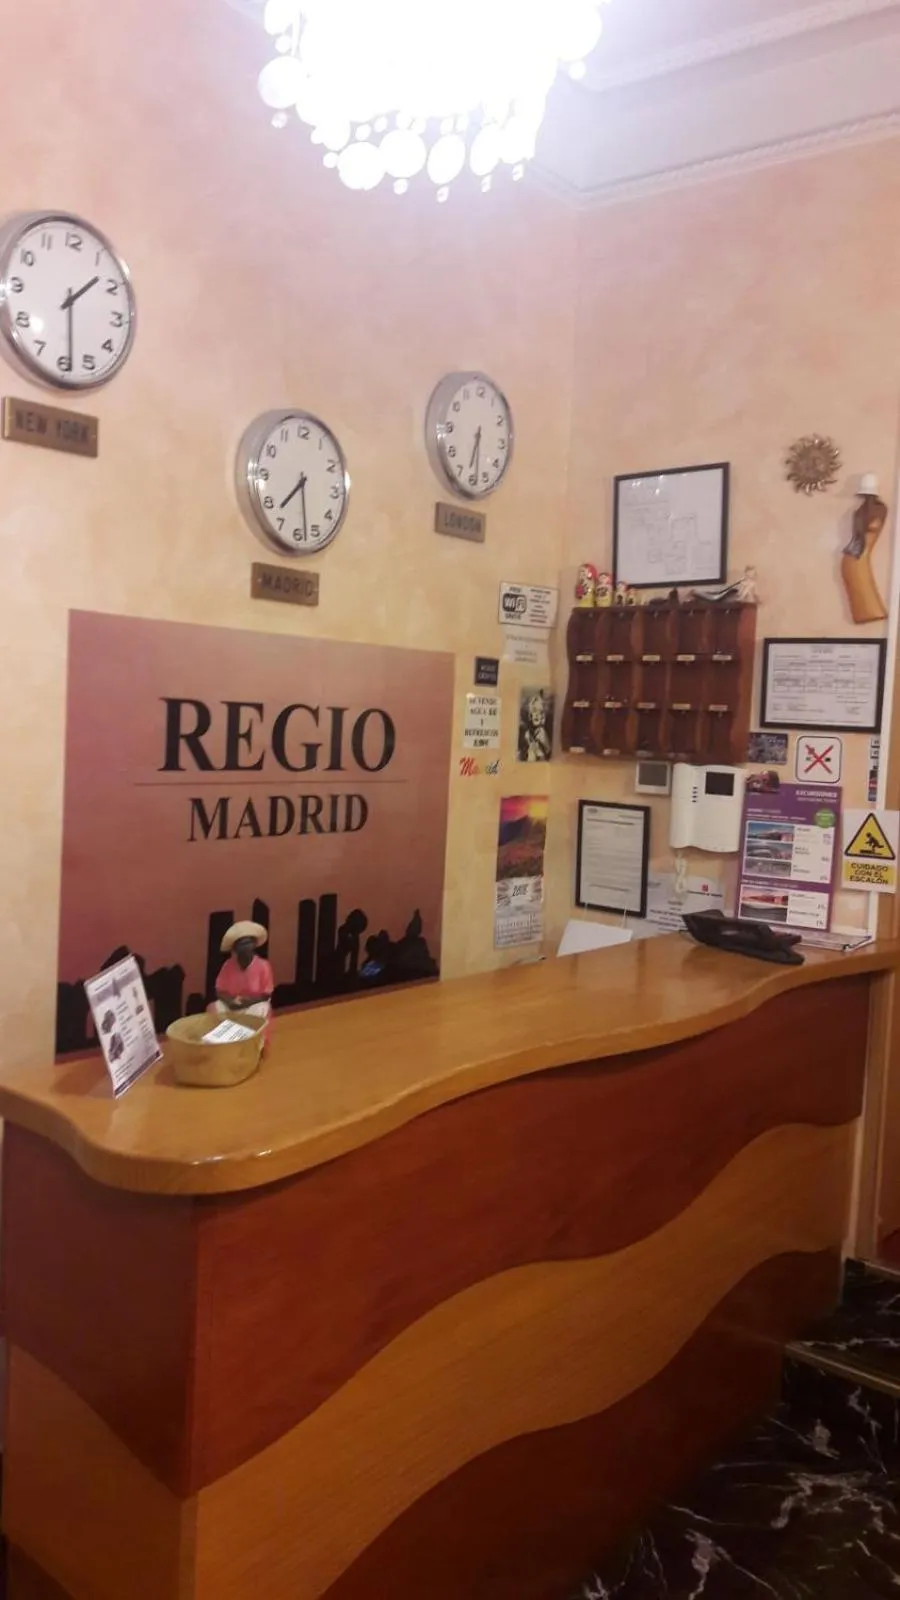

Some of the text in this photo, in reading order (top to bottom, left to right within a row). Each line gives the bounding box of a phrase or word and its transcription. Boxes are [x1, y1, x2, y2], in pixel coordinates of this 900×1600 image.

[41, 232, 52, 251] 11
[65, 232, 82, 252] 12
[20, 249, 35, 267] 10
[95, 251, 100, 267] 1
[10, 277, 24, 294] 9
[106, 279, 118, 296] 2
[16, 311, 30, 328] 8
[110, 311, 124, 328] 3
[33, 340, 46, 357] 7
[101, 339, 114, 354] 4
[56, 355, 71, 372] 6
[82, 354, 96, 371] 5
[463, 388, 470, 400] 11
[446, 421, 454, 433] 9
[496, 415, 503, 427] 2
[280, 429, 289, 442] 11
[297, 426, 309, 440] 12
[497, 438, 505, 450] 3
[265, 445, 277, 458] 10
[448, 446, 456, 458] 8
[326, 459, 336, 473] 2
[456, 464, 463, 476] 7
[492, 458, 499, 469] 4
[259, 468, 269, 481] 9
[468, 474, 477, 486] 6
[481, 472, 489, 483] 5
[330, 486, 340, 500] 3
[263, 496, 274, 509] 8
[324, 509, 333, 521] 4
[276, 518, 286, 531] 7
[311, 525, 320, 538] 5
[292, 528, 303, 542] 6
[260, 570, 314, 598] MADRID
[157, 697, 397, 774] REGIO
[187, 792, 369, 843] MADRID
[850, 863, 889, 873] CUIDADO
